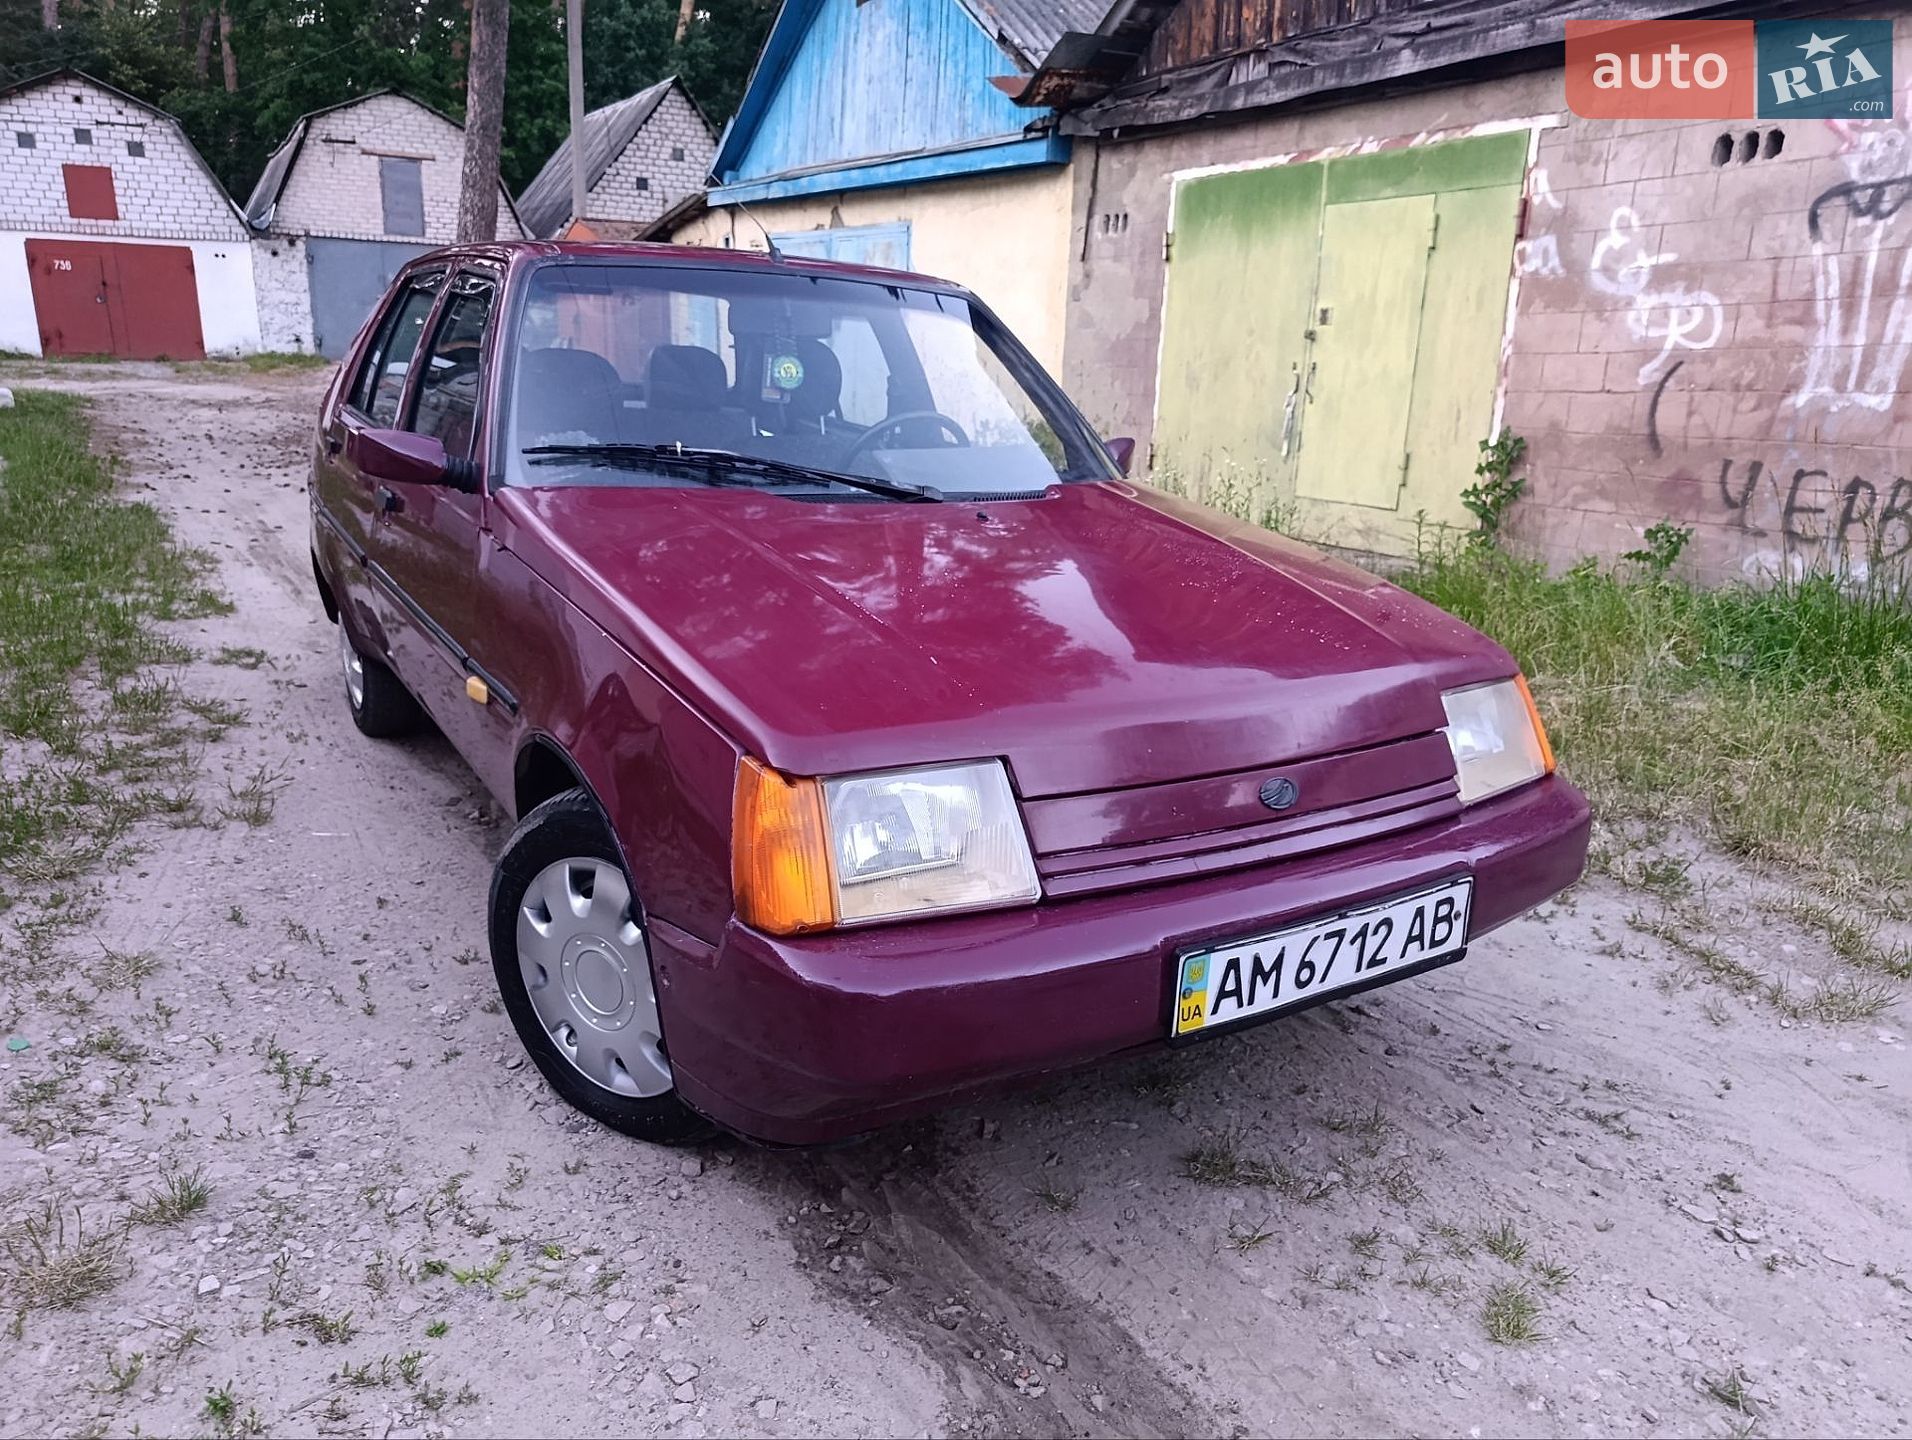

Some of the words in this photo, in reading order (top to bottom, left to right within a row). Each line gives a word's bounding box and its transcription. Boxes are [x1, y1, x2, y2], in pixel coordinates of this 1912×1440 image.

[1210, 946, 1286, 1016] AM
[1295, 917, 1394, 990] 6712
[1399, 897, 1455, 959] AB
[1181, 1004, 1202, 1022] UA
